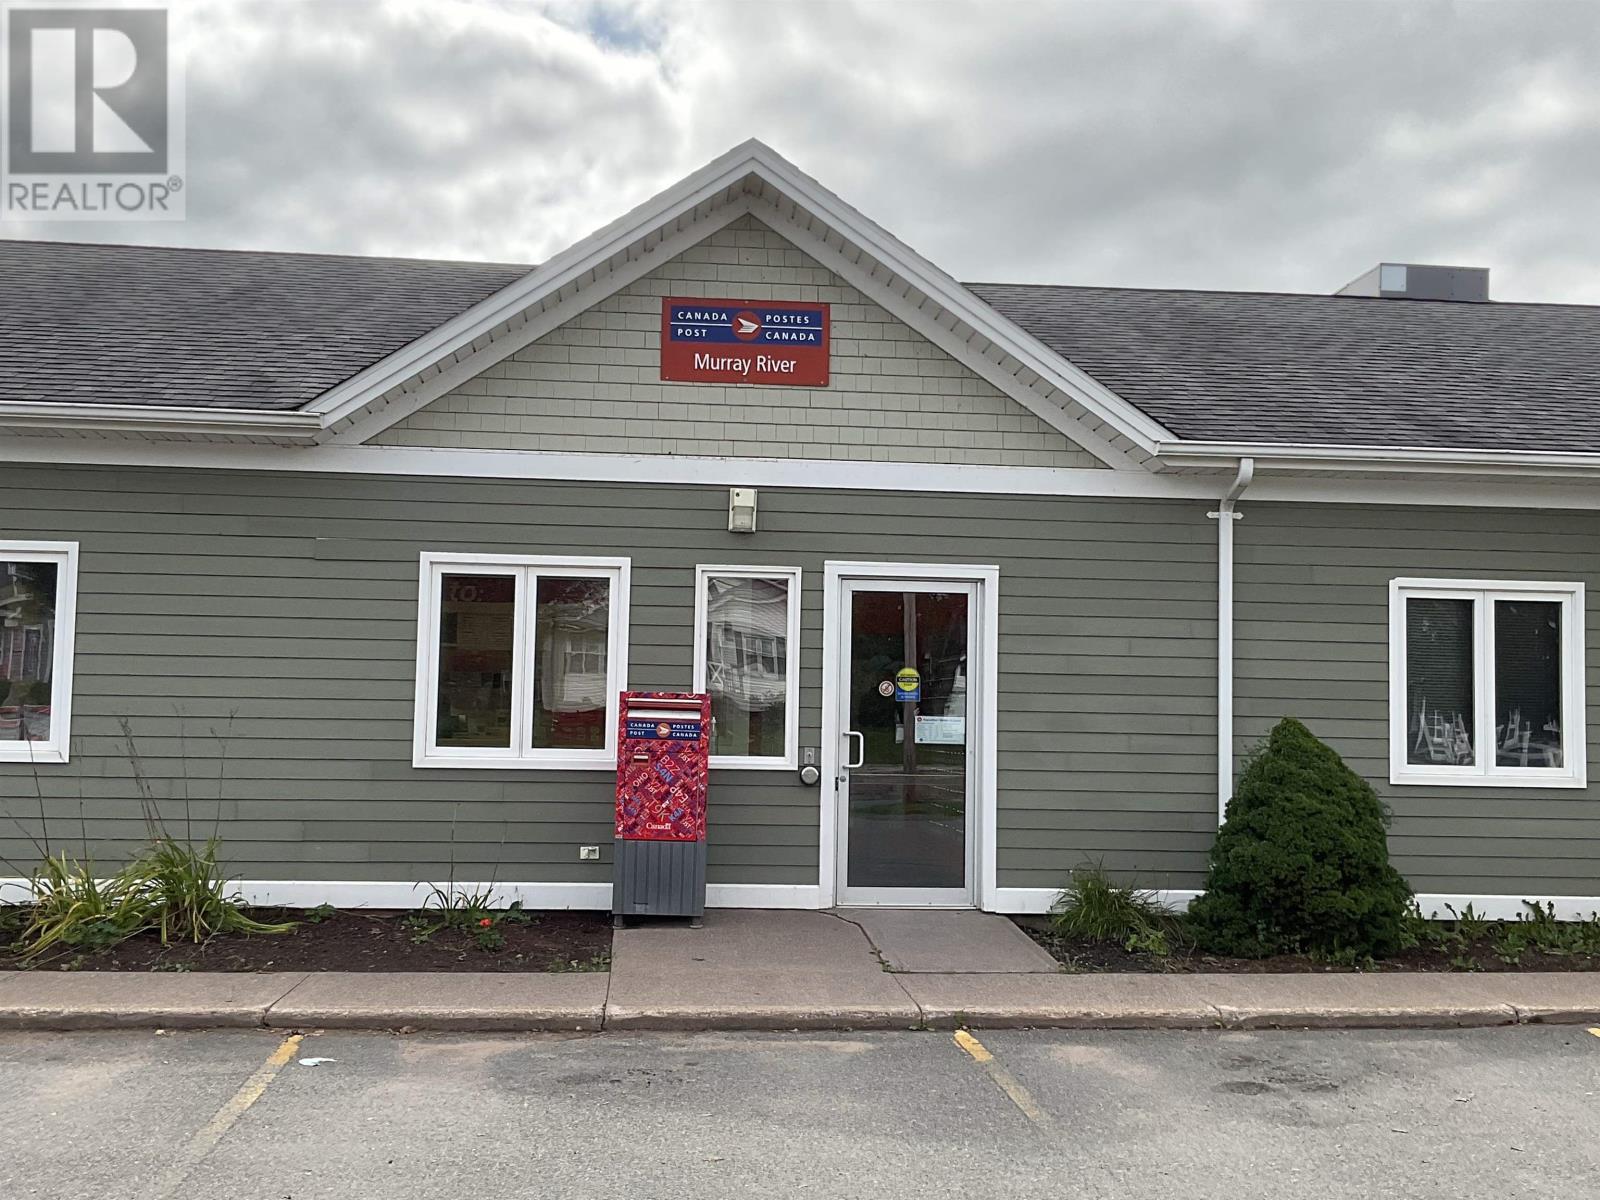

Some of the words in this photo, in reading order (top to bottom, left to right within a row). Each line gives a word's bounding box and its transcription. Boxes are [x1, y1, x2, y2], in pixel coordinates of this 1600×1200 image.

[677, 311, 728, 321] CANADA
[766, 314, 810, 324] POSTES
[677, 328, 707, 337] POST
[765, 331, 815, 341] CANADA
[694, 353, 751, 375] Murray
[756, 355, 796, 373] River
